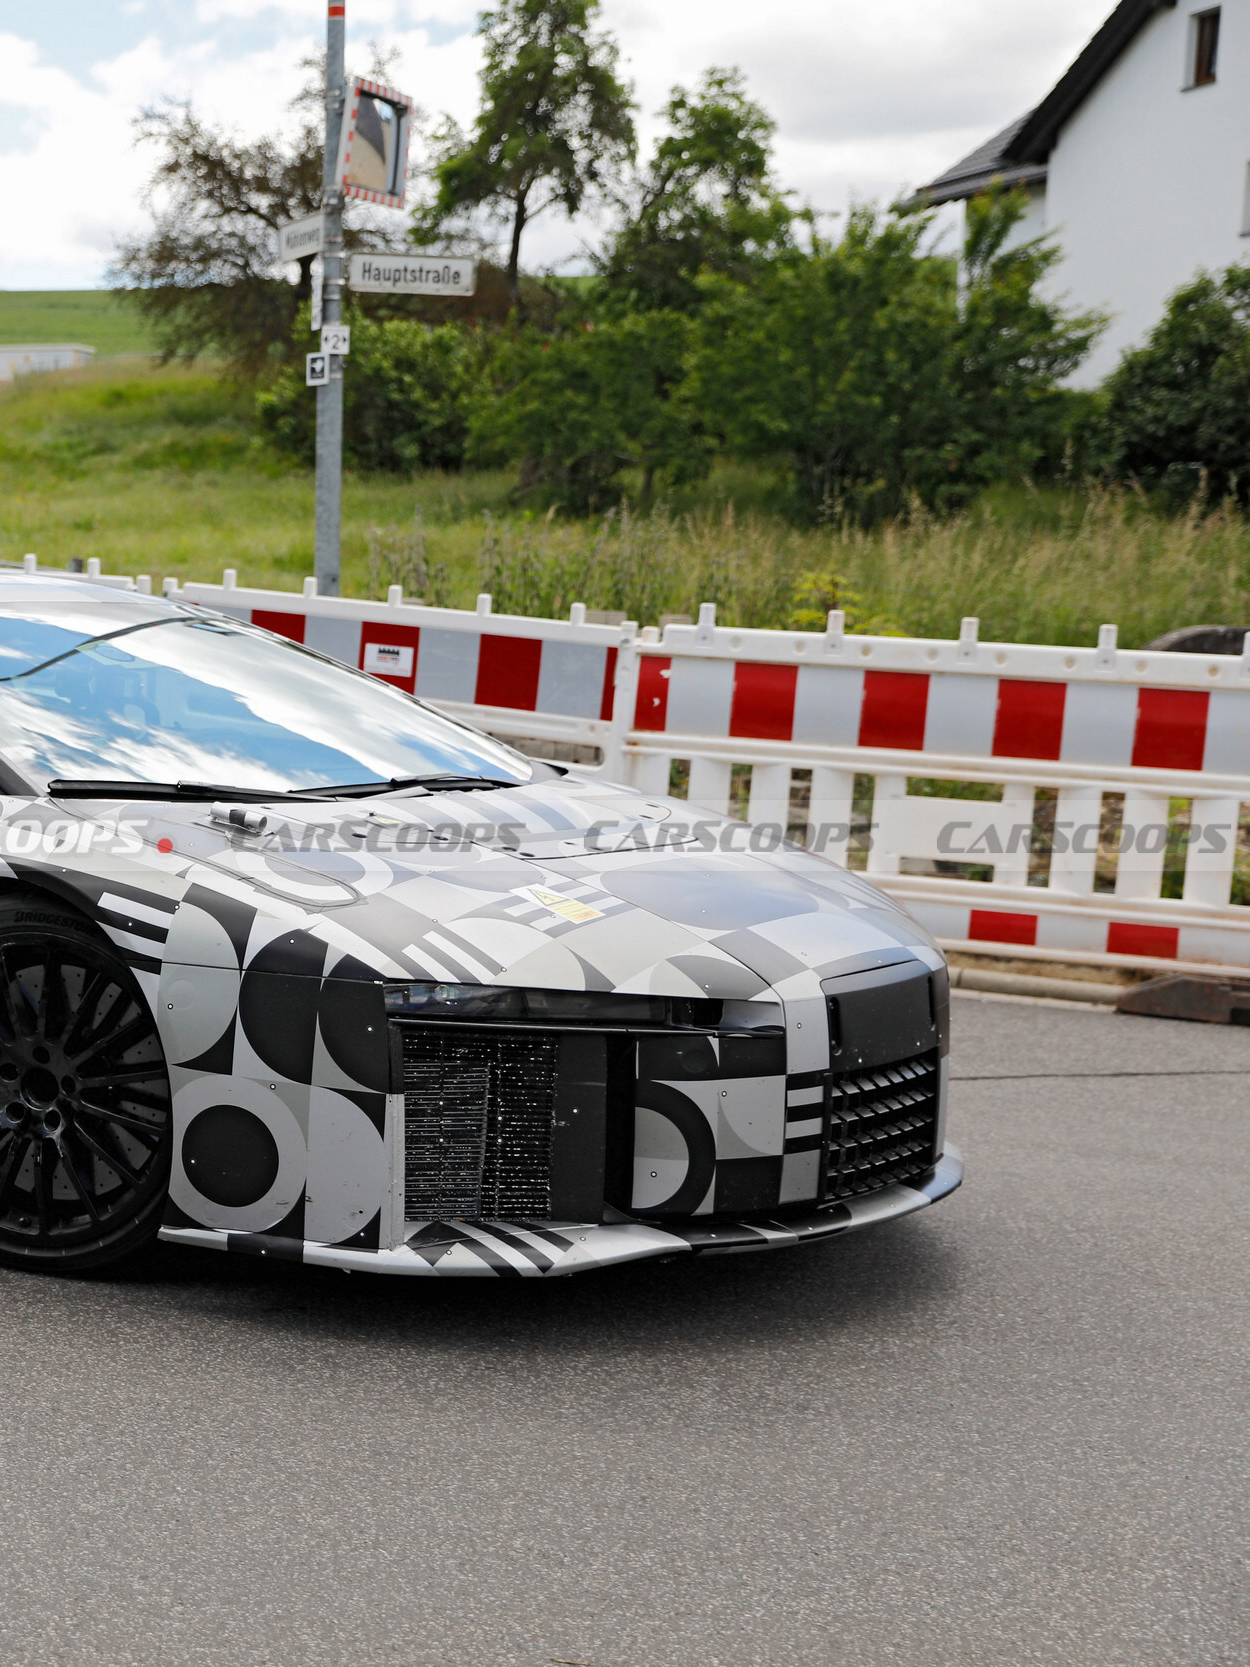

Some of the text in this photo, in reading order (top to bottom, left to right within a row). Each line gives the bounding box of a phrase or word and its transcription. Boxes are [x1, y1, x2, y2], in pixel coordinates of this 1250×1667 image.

[362, 262, 461, 287] Hauptstraße
[332, 334, 339, 350] 2
[14, 911, 99, 938] BRIDGESTONE
